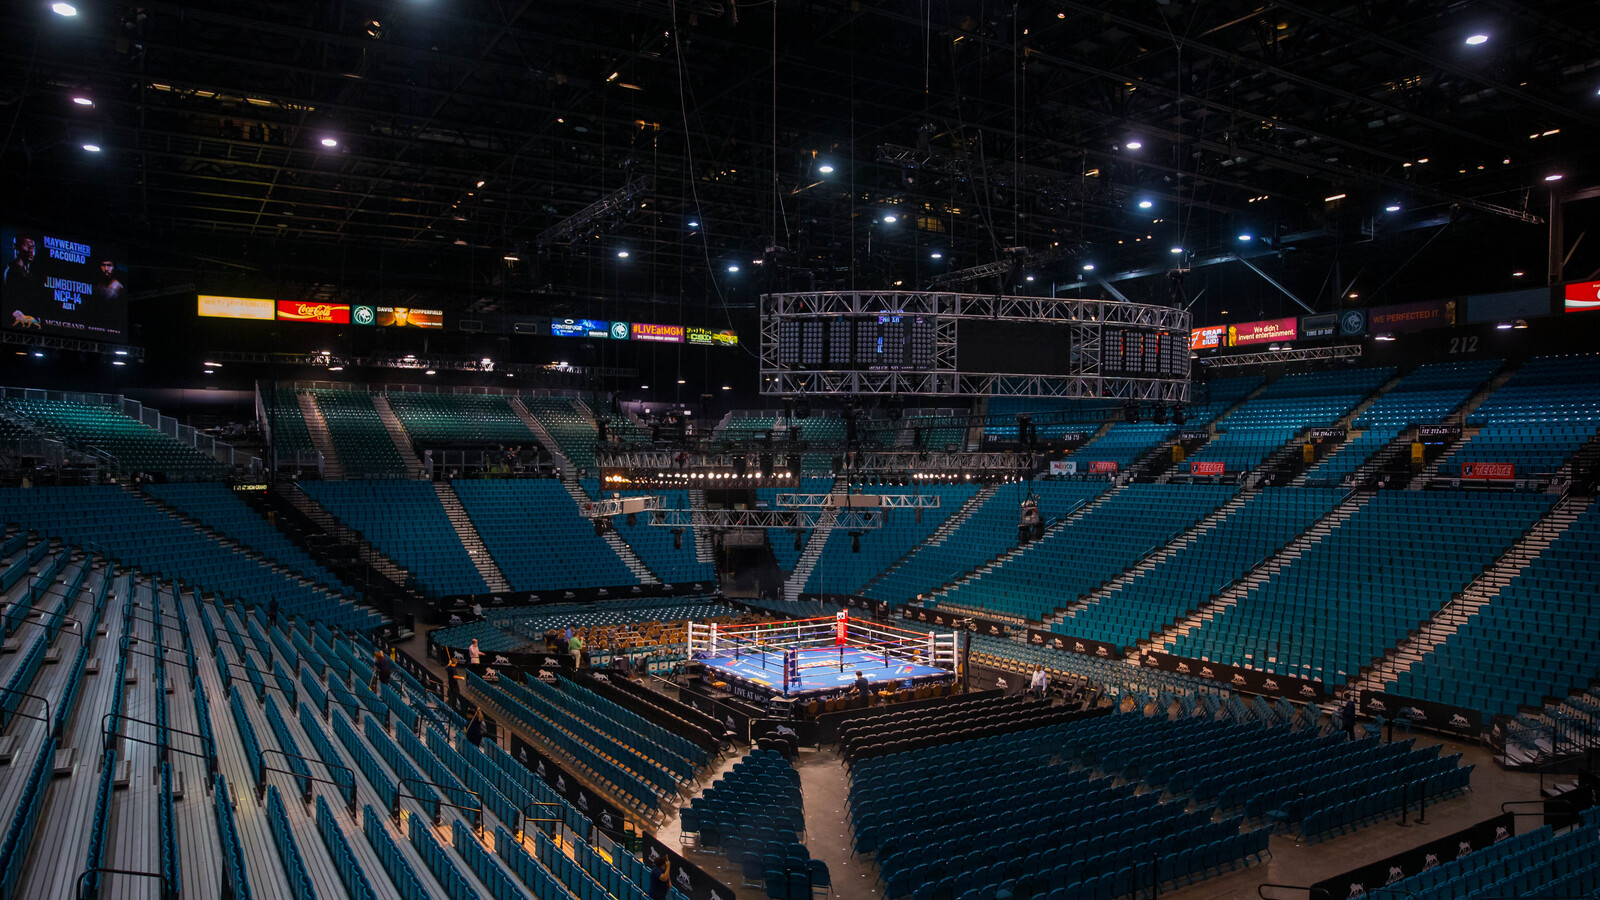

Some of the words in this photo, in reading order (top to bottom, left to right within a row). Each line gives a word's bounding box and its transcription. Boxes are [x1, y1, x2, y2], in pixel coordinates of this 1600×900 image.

[44, 236, 91, 254] MAYWEATHER
[50, 249, 86, 264] PACQUIAO
[44, 276, 92, 295] JUMBOTRON
[54, 289, 82, 305] NCP-14
[62, 302, 72, 310] AUX
[298, 303, 331, 316] Coca-Cola
[410, 308, 443, 316] COPPERFIELD
[1373, 315, 1385, 324] WE
[1386, 310, 1430, 322] PERFECTED
[45, 319, 61, 328] MGM
[62, 322, 85, 331] GRAND
[633, 324, 683, 336] #LIVEatMGM
[1264, 324, 1279, 332] didn't
[1239, 333, 1254, 341] invent
[1449, 335, 1479, 353] 212
[1200, 462, 1224, 473] TECATE
[1474, 464, 1513, 476] TECATE
[734, 686, 746, 697] LIVE
[747, 691, 753, 700] AT
